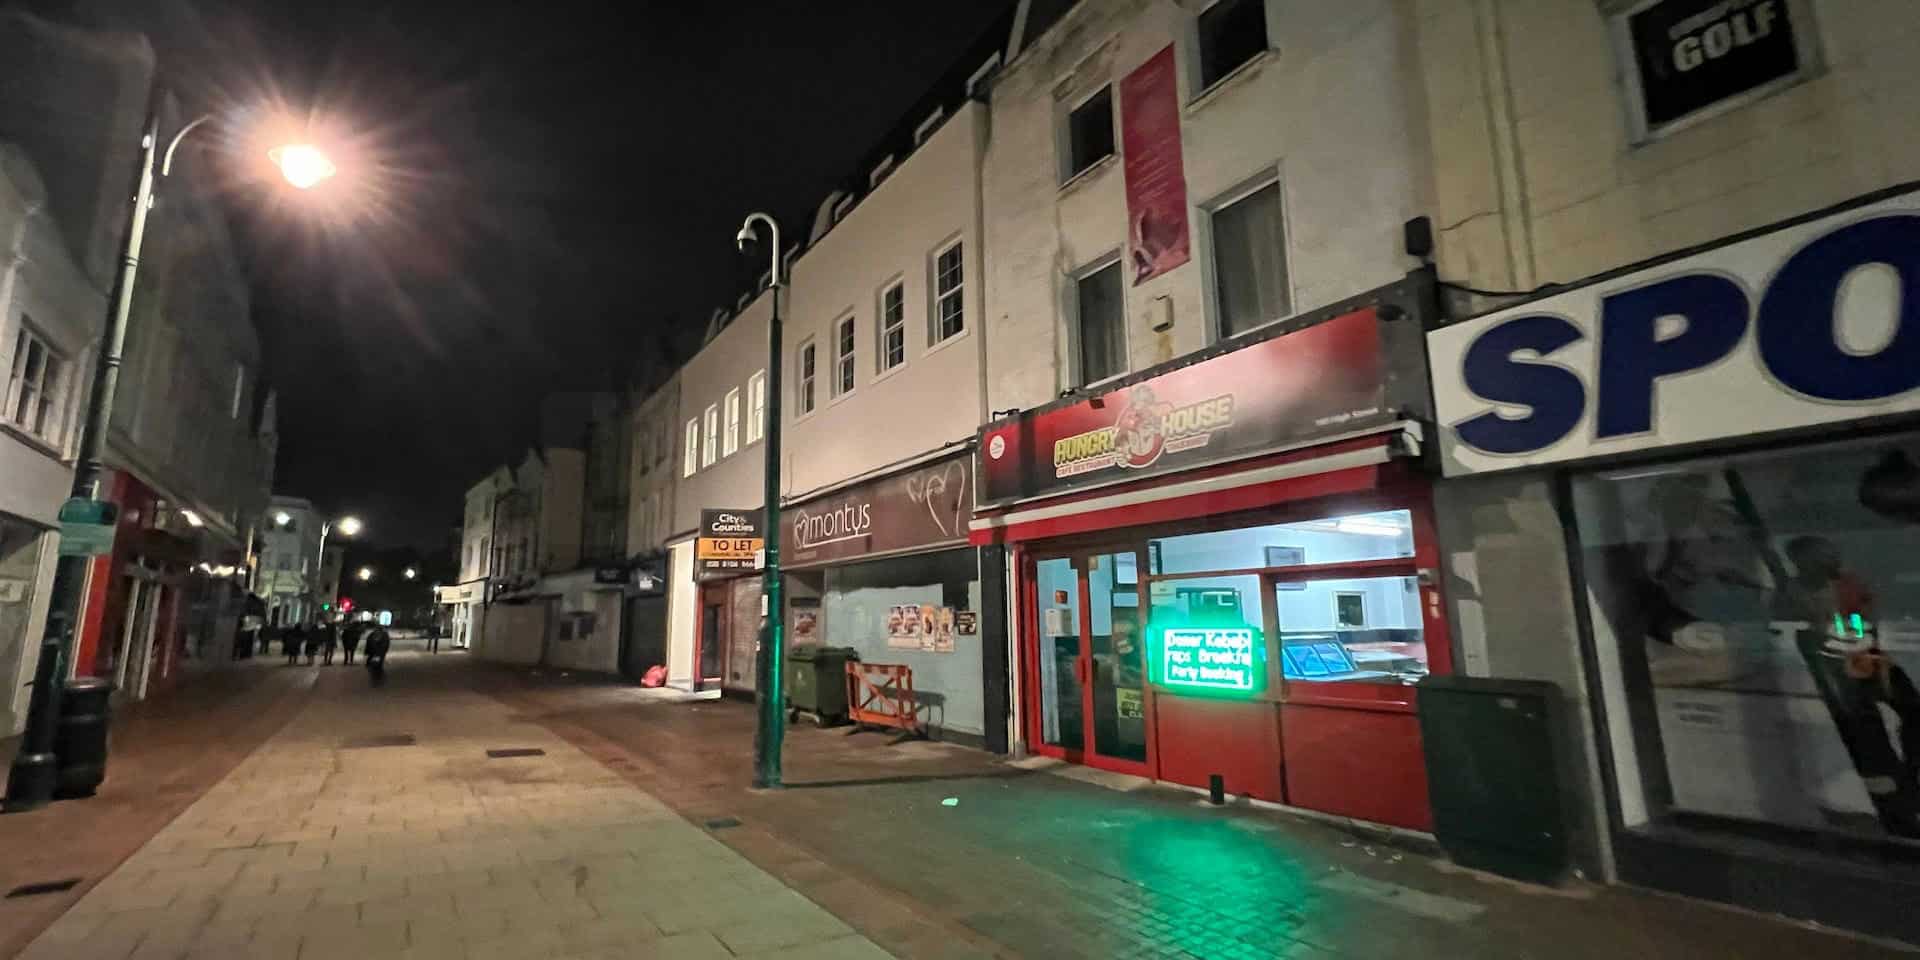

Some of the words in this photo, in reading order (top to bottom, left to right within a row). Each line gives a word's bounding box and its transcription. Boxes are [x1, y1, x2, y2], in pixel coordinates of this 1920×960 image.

[1672, 0, 1777, 71] GOLF
[1455, 214, 1920, 454] SPO
[1055, 428, 1116, 464] HUNGRY
[1160, 396, 1233, 438] HOUSE
[711, 522, 754, 532] Counties
[719, 513, 740, 525] City
[809, 503, 871, 539] montys
[712, 540, 729, 551] TO
[734, 540, 753, 551] LET
[1172, 665, 1198, 681] Party
[1200, 666, 1244, 687] Booking
